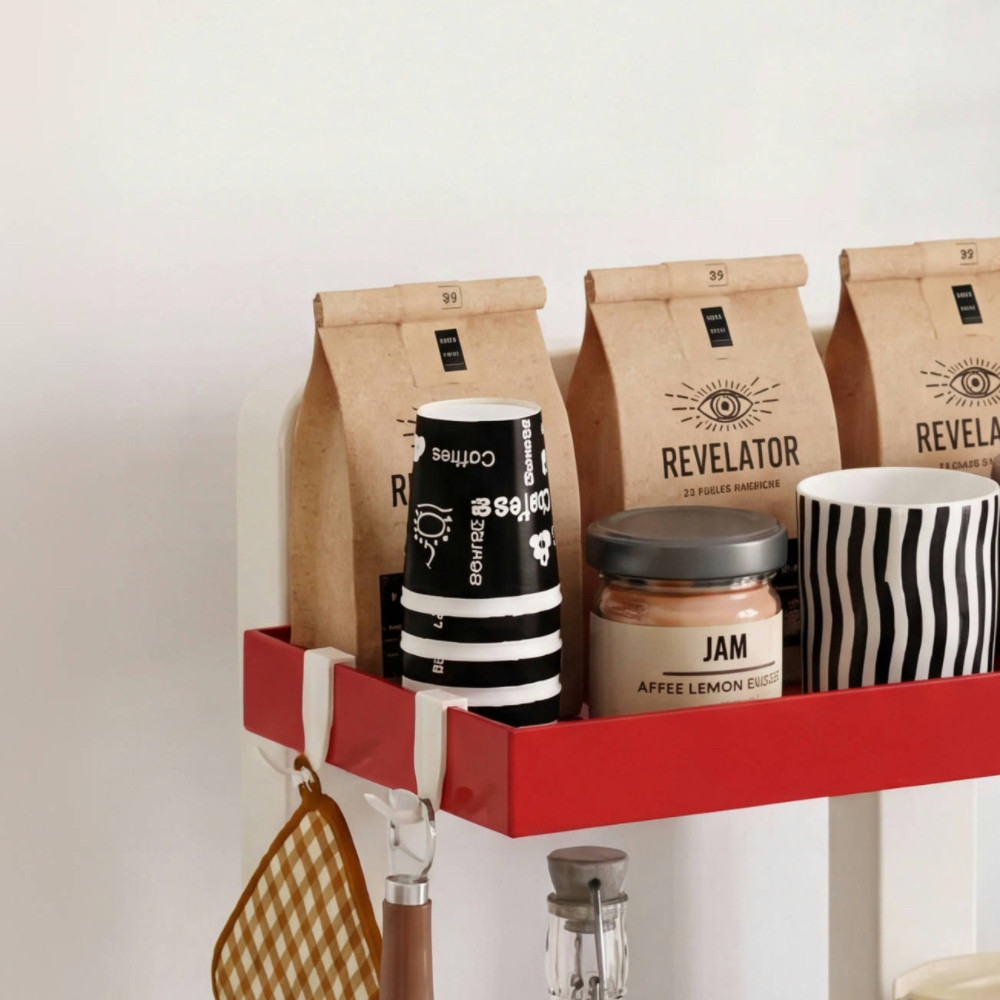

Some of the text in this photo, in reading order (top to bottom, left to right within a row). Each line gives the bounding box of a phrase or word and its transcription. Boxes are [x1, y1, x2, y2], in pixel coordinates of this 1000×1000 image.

[661, 435, 800, 479] REVELATOR
[702, 633, 748, 662] JAM
[637, 681, 684, 695] AFFEE
[688, 679, 743, 695] LEMON
